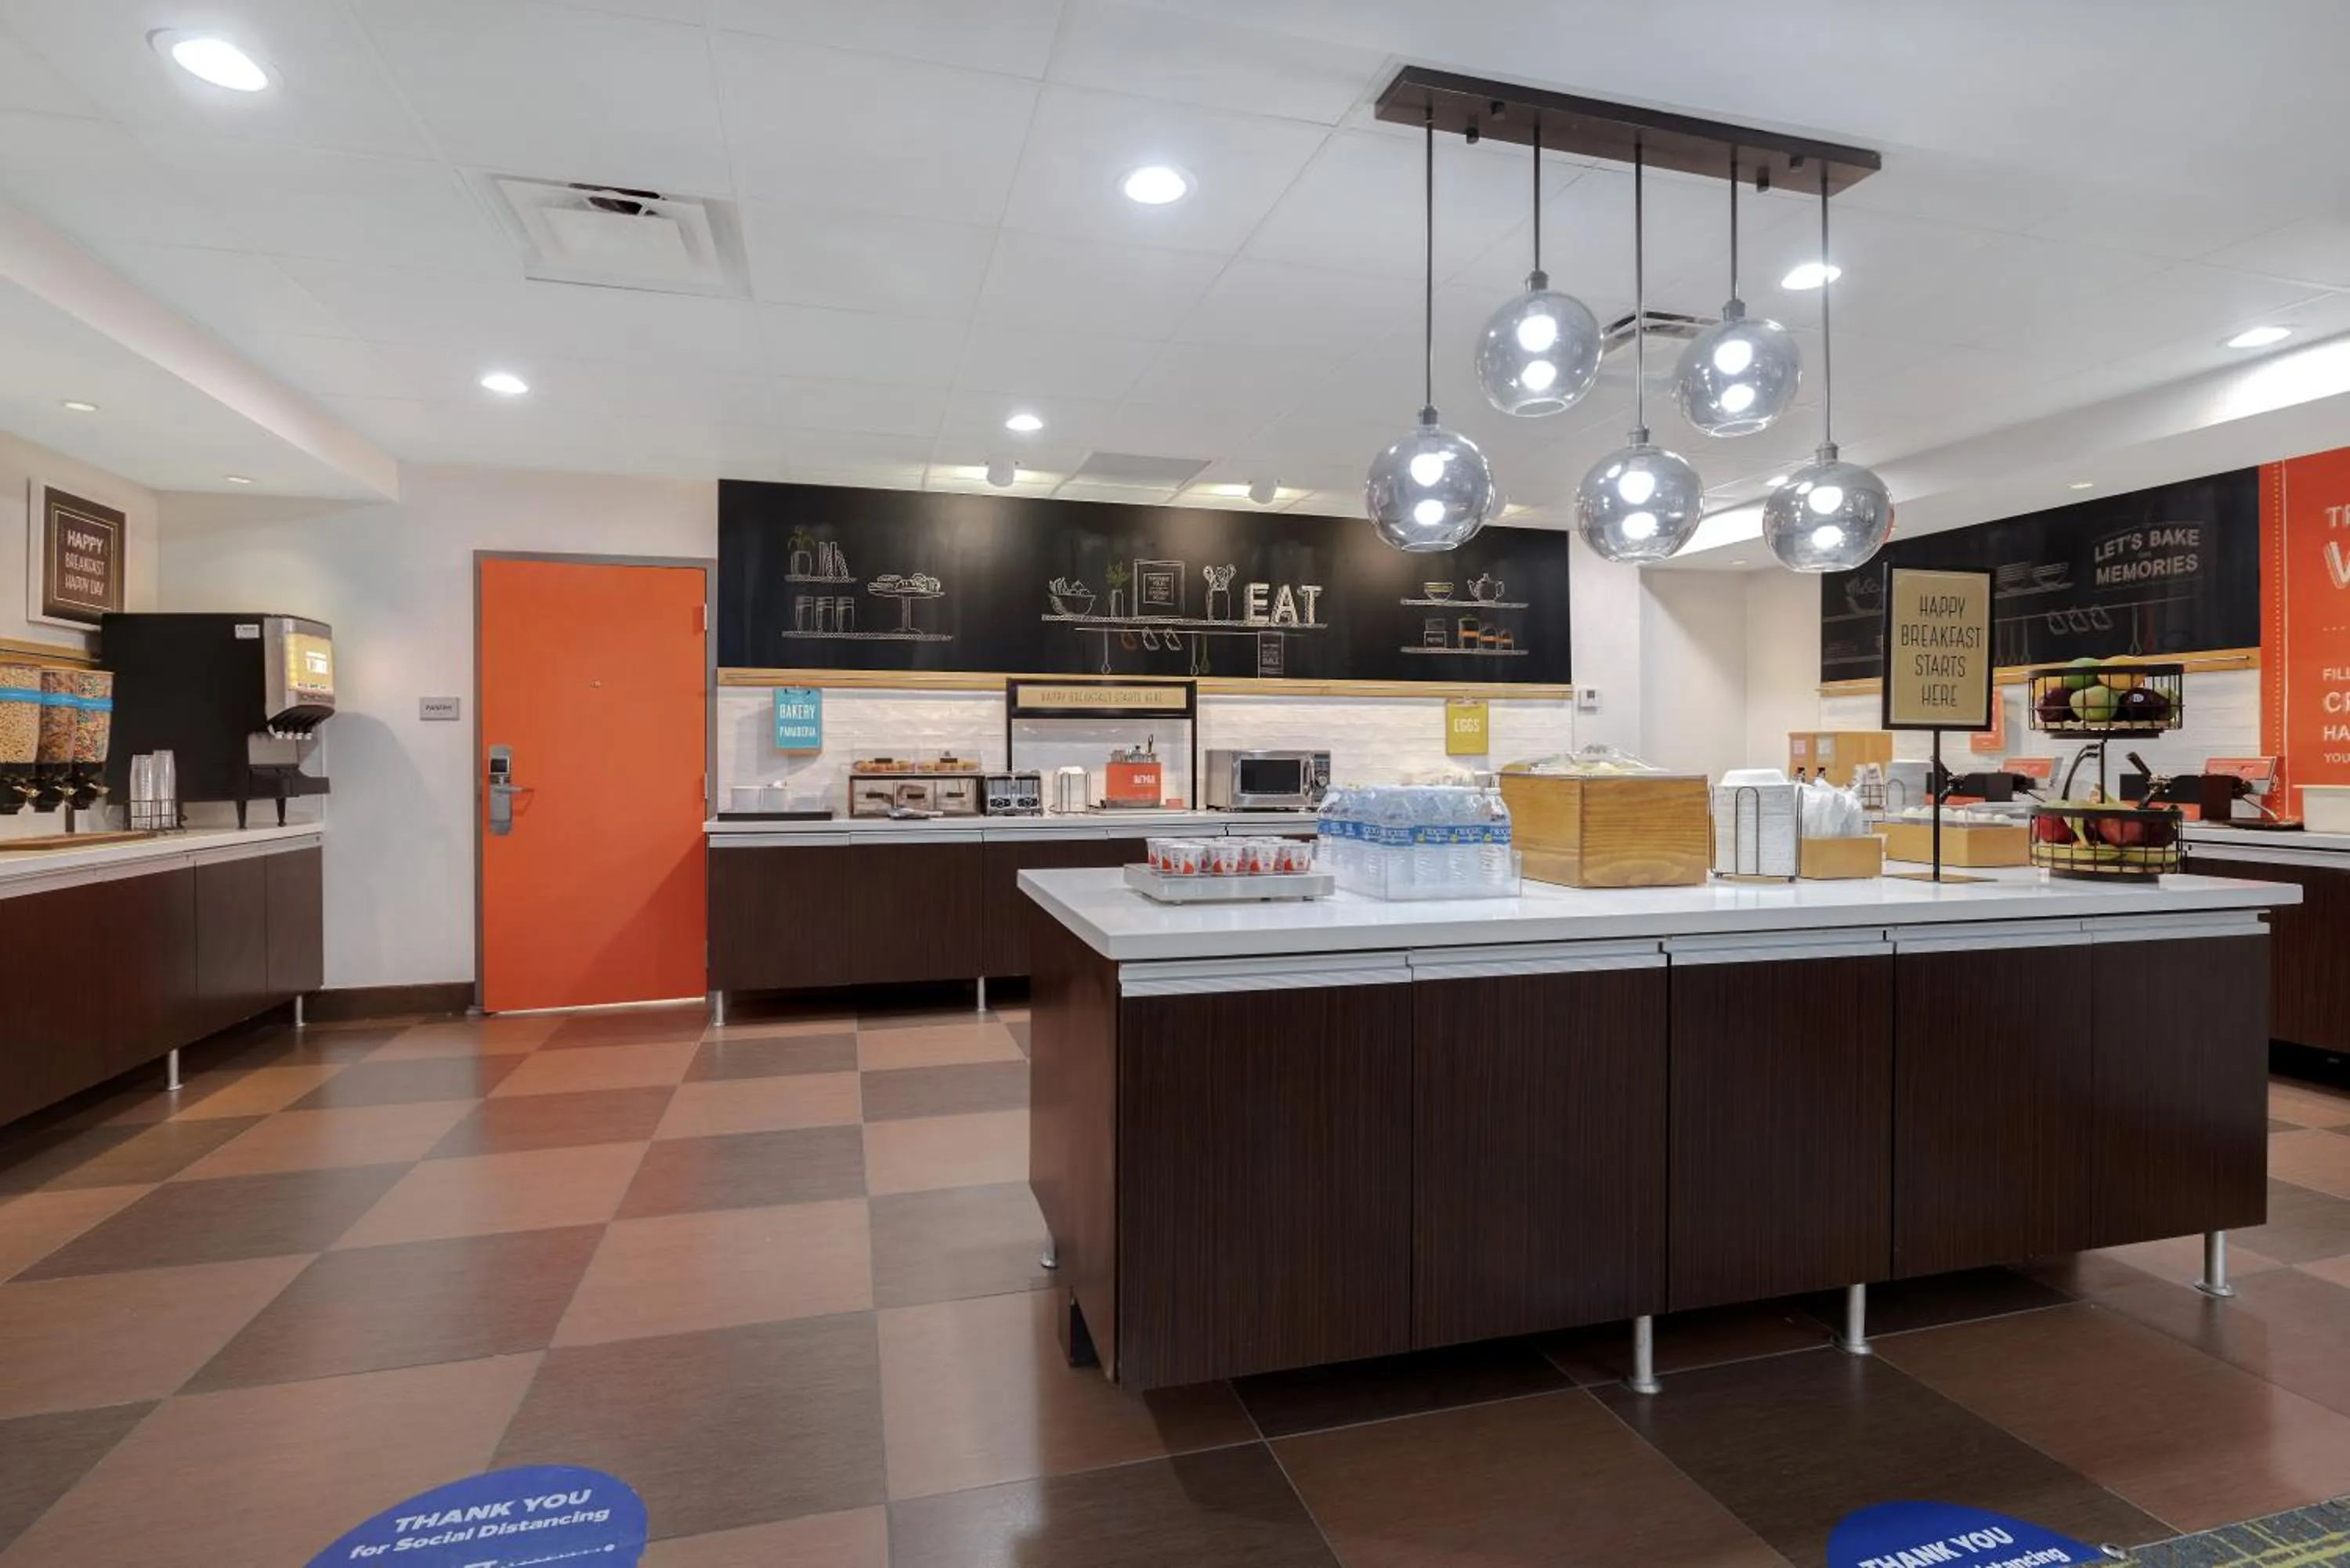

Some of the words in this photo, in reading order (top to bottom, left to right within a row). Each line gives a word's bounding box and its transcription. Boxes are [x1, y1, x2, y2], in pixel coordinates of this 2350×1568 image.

[67, 529, 103, 555] HAPPY
[2095, 533, 2142, 562] LET'S
[2149, 529, 2200, 547] BAKE
[2095, 554, 2199, 586] MEMORIES
[1243, 583, 1323, 627] EAT
[1920, 594, 1965, 619] HAPPY
[1901, 624, 1980, 649] BREAKFAST
[1915, 654, 1966, 677] STARTS
[1922, 684, 1958, 707] HERE
[779, 703, 815, 720] BAKERY
[1454, 717, 1480, 732] EGGS
[396, 1501, 514, 1533] THANK
[523, 1489, 592, 1512] YOU
[349, 1544, 391, 1559] for
[392, 1526, 478, 1552] Social
[478, 1508, 611, 1539] Distancing
[1949, 1526, 2014, 1553] YOU
